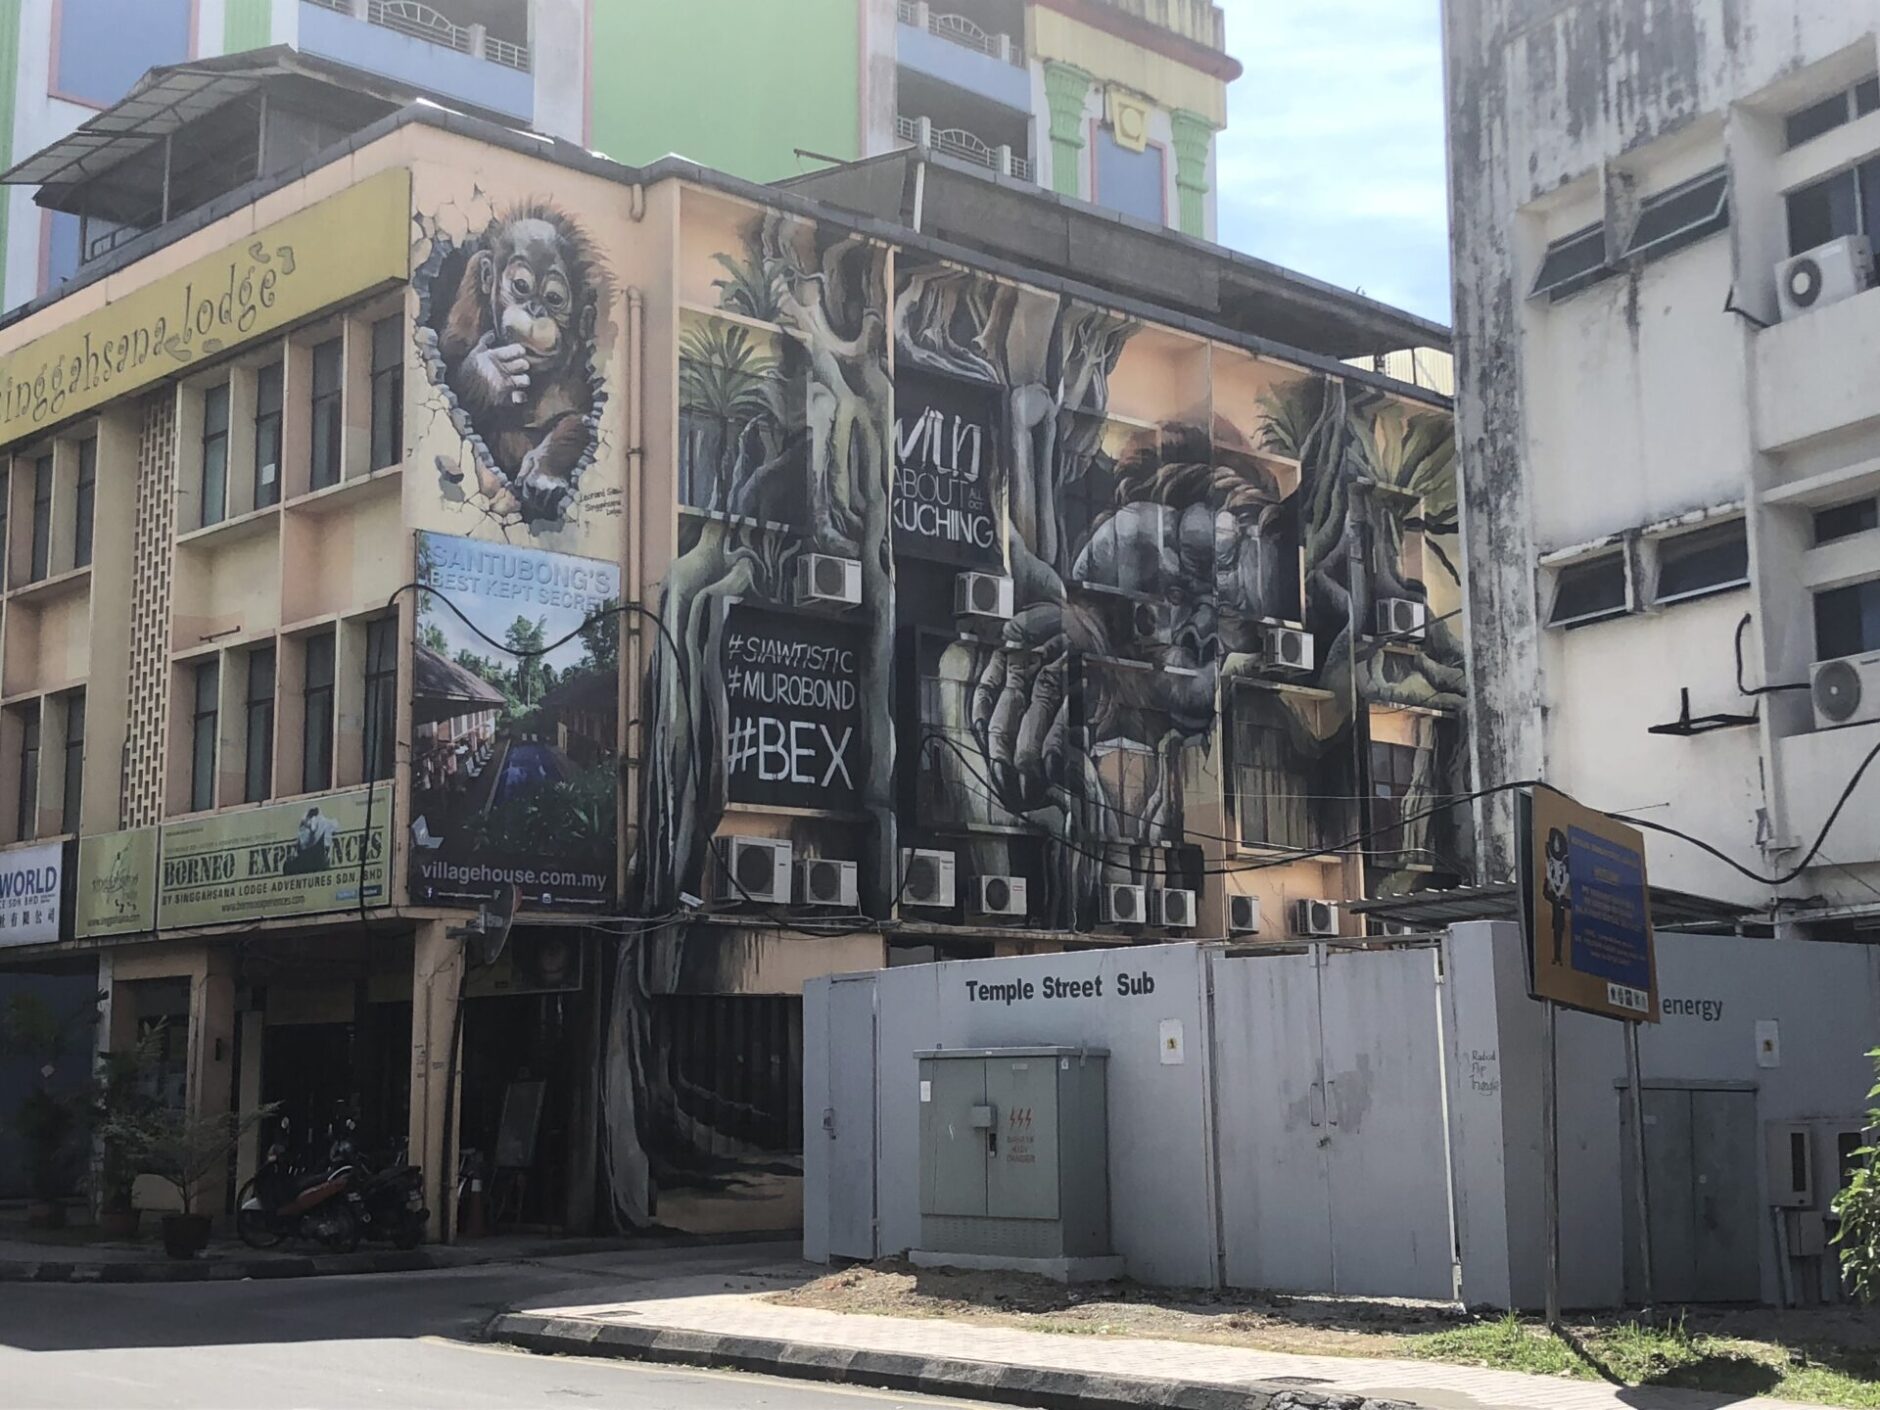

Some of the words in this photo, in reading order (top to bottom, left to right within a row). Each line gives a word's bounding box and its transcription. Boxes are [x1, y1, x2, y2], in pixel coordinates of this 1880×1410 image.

[0, 317, 167, 424] inggahsana
[182, 262, 277, 345] lodge
[430, 545, 611, 594] SANTUBONG'S
[430, 568, 480, 594] BEST
[485, 579, 534, 601] KEPT
[728, 633, 853, 674] #SIAWTISTIC
[728, 665, 855, 711] #MUROBOND
[728, 716, 854, 790] #BEX
[0, 866, 57, 899] WORLD
[164, 853, 236, 888] BORNEO
[421, 861, 607, 892] villagehouse.com.my
[175, 886, 236, 905] SINGGAHSANA
[239, 882, 268, 897] LODGE
[271, 875, 332, 892] ADVENTURES
[965, 978, 1035, 1006] Temple
[1042, 975, 1103, 999] Street
[1117, 971, 1156, 997] Sub
[1662, 998, 1724, 1022] energy
